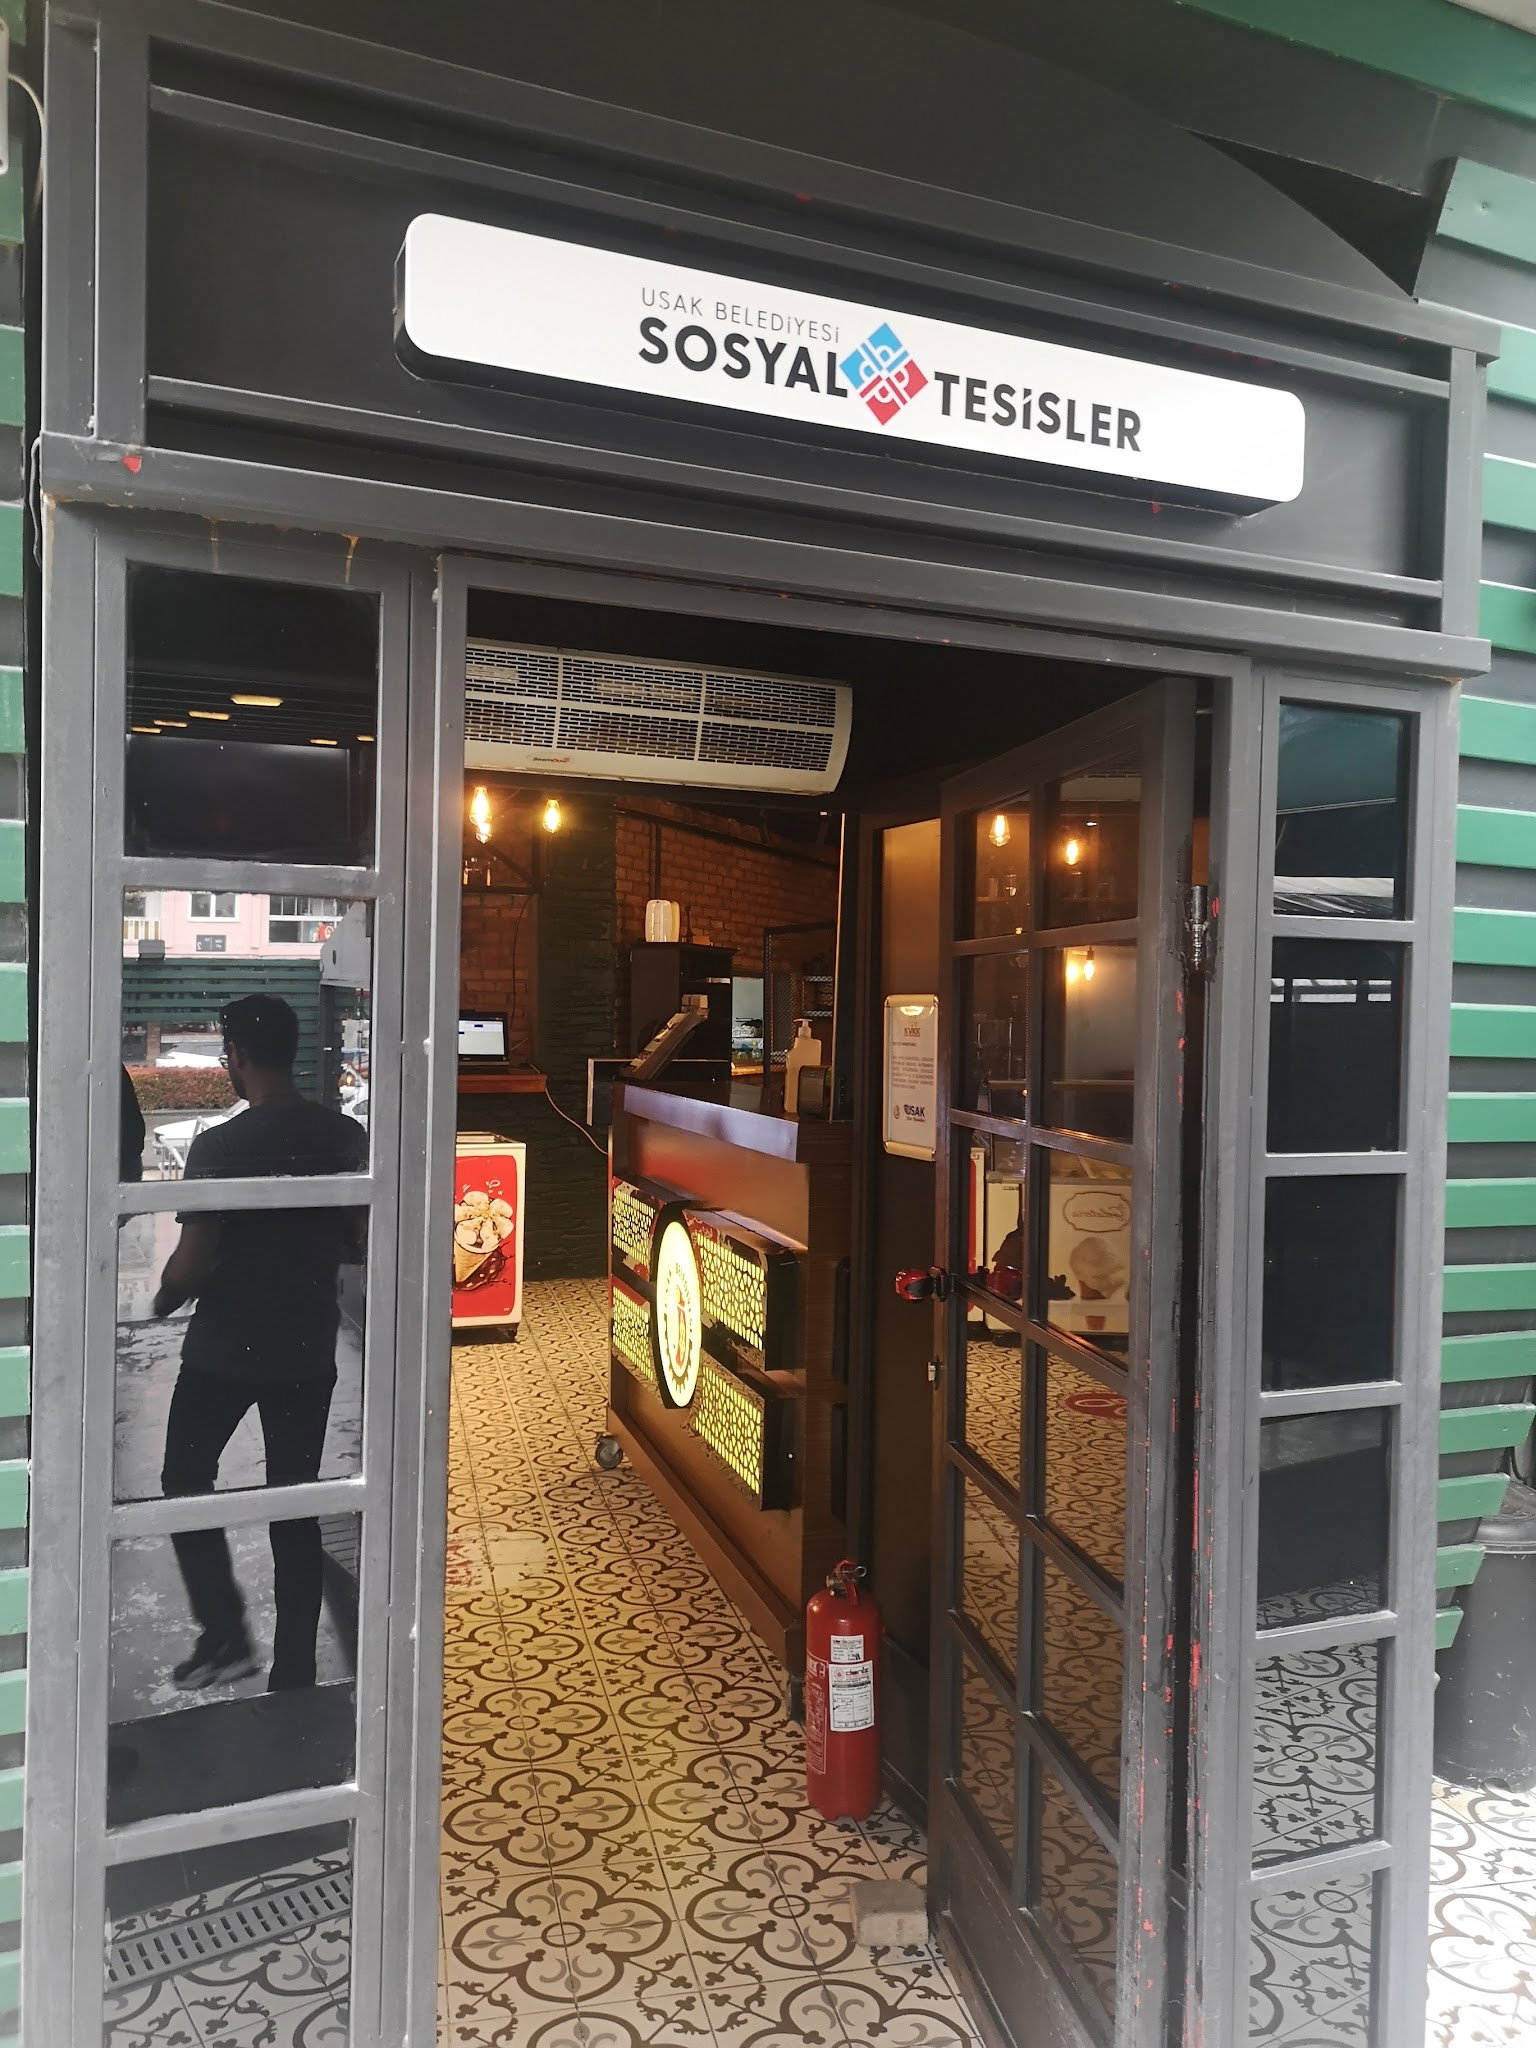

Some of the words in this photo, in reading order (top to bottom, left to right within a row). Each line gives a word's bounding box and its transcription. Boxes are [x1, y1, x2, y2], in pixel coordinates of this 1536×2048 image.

[642, 287, 702, 316] USAK
[639, 317, 848, 398] SOSYAL
[935, 371, 1141, 452] TESİSLER
